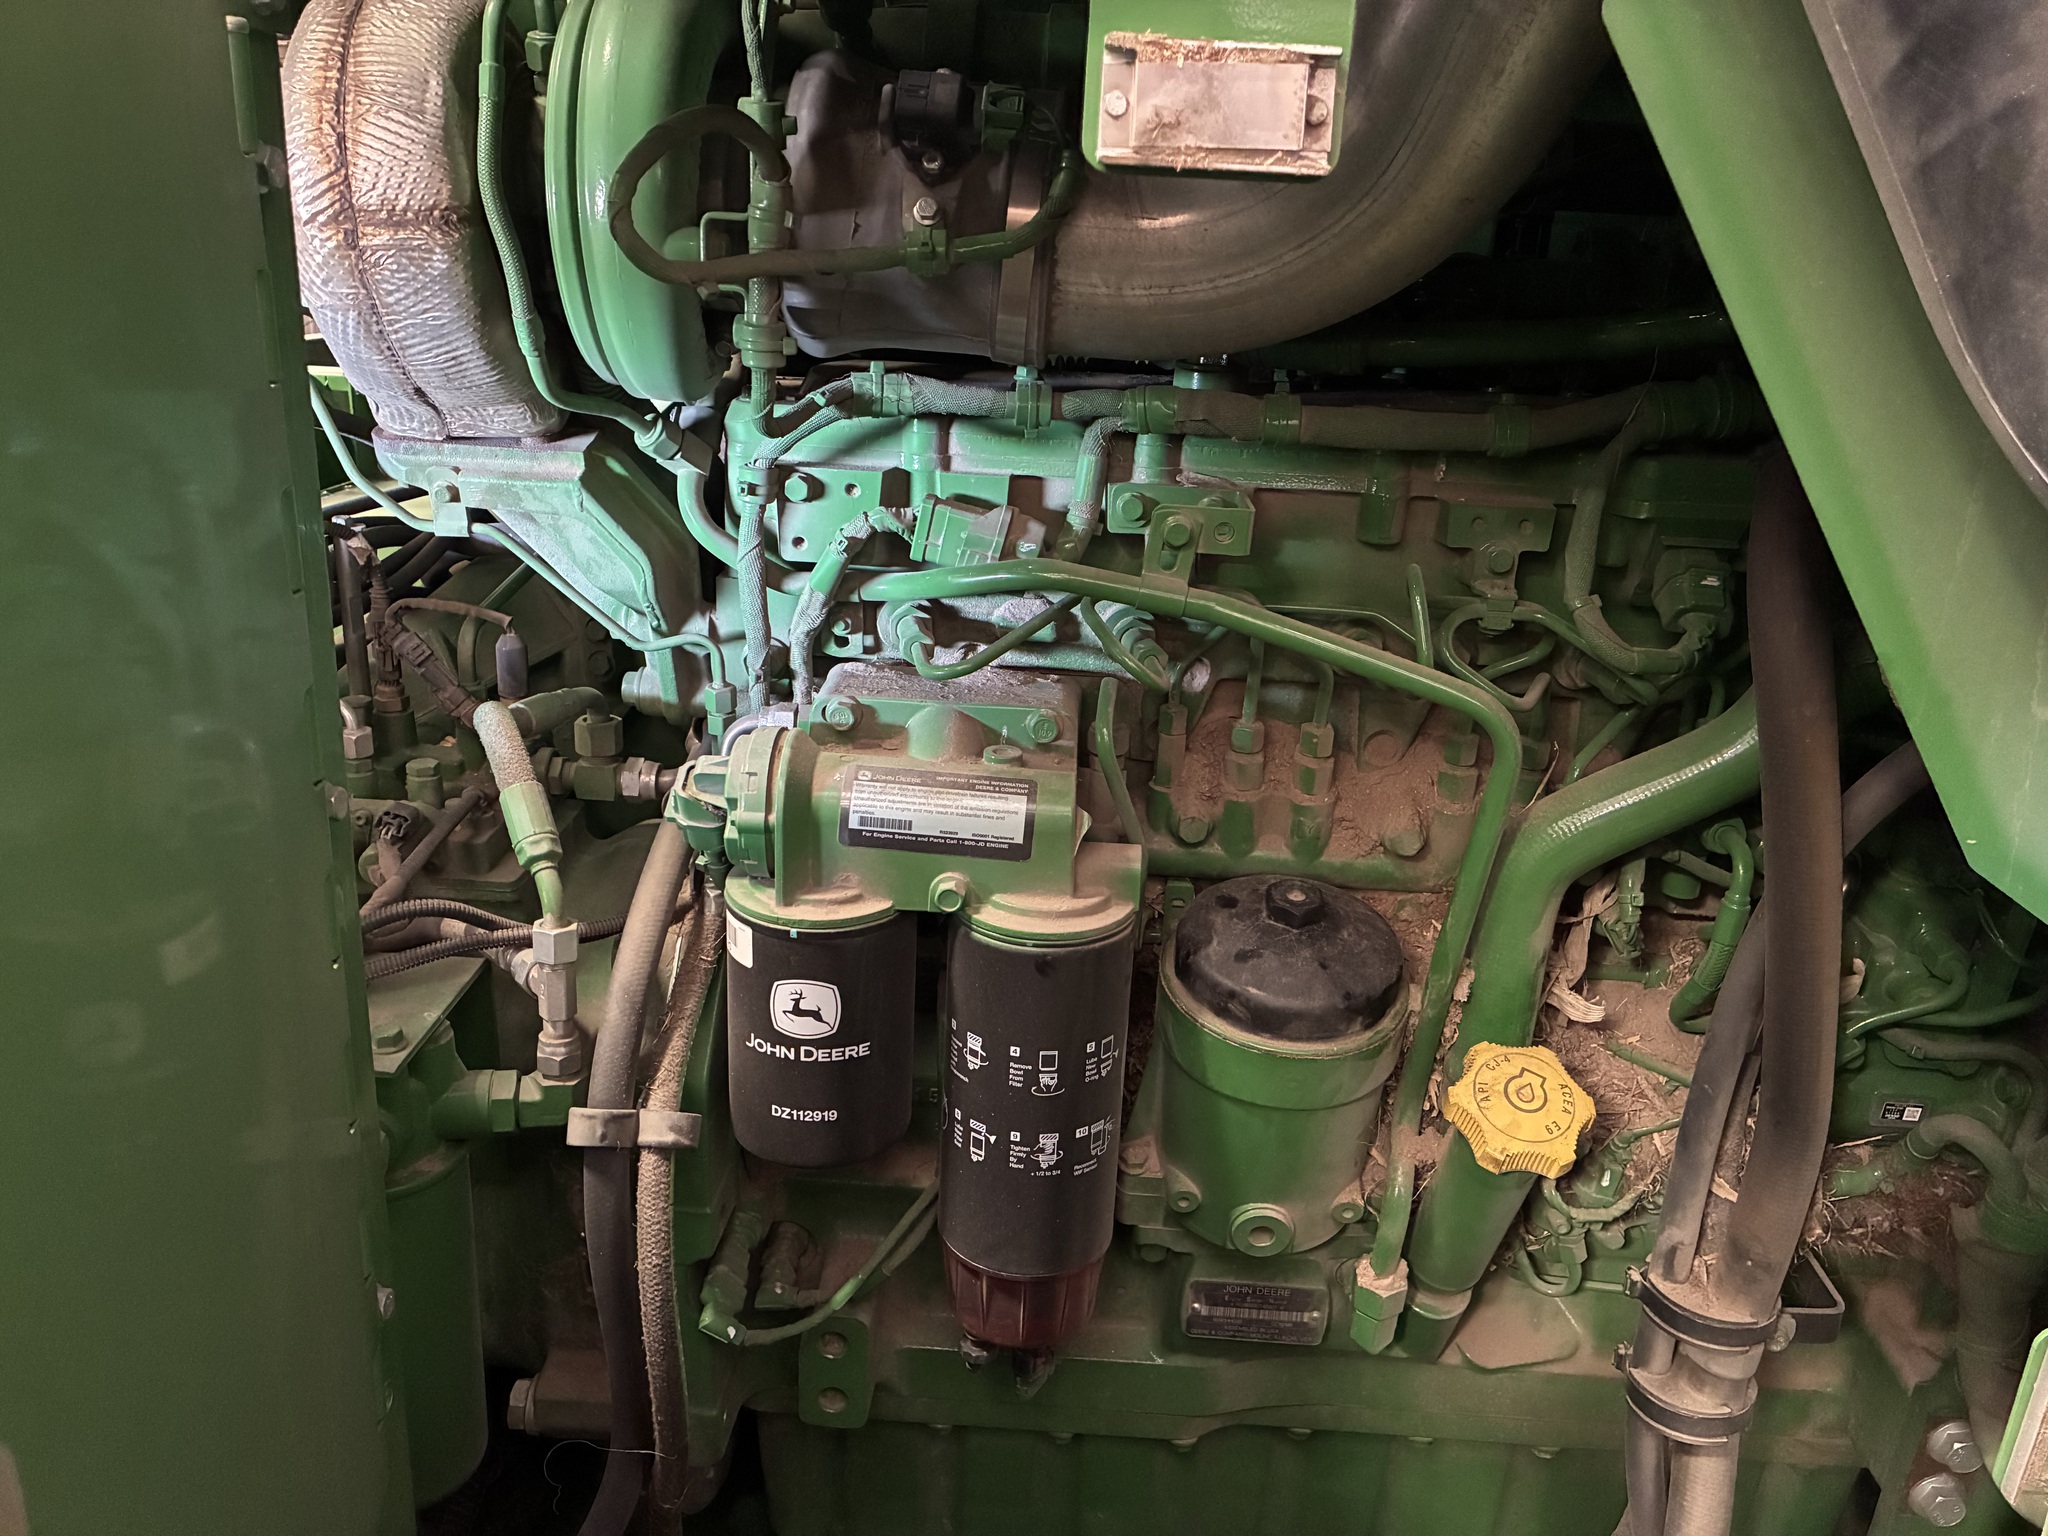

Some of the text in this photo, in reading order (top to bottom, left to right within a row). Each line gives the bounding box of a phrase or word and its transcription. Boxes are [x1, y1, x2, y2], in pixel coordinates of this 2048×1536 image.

[896, 776, 922, 784] DEERE
[854, 795, 886, 803] Unauthorized
[888, 798, 917, 806] adjustments
[746, 1033, 870, 1062] JOHN DEERE
[1010, 1062, 1032, 1070] Remove
[1478, 1054, 1511, 1102] API CJ-4
[772, 1104, 838, 1122] DZ112919
[1544, 1083, 1574, 1135] ACEA E9
[1224, 1285, 1292, 1296] JOHN DEERE
